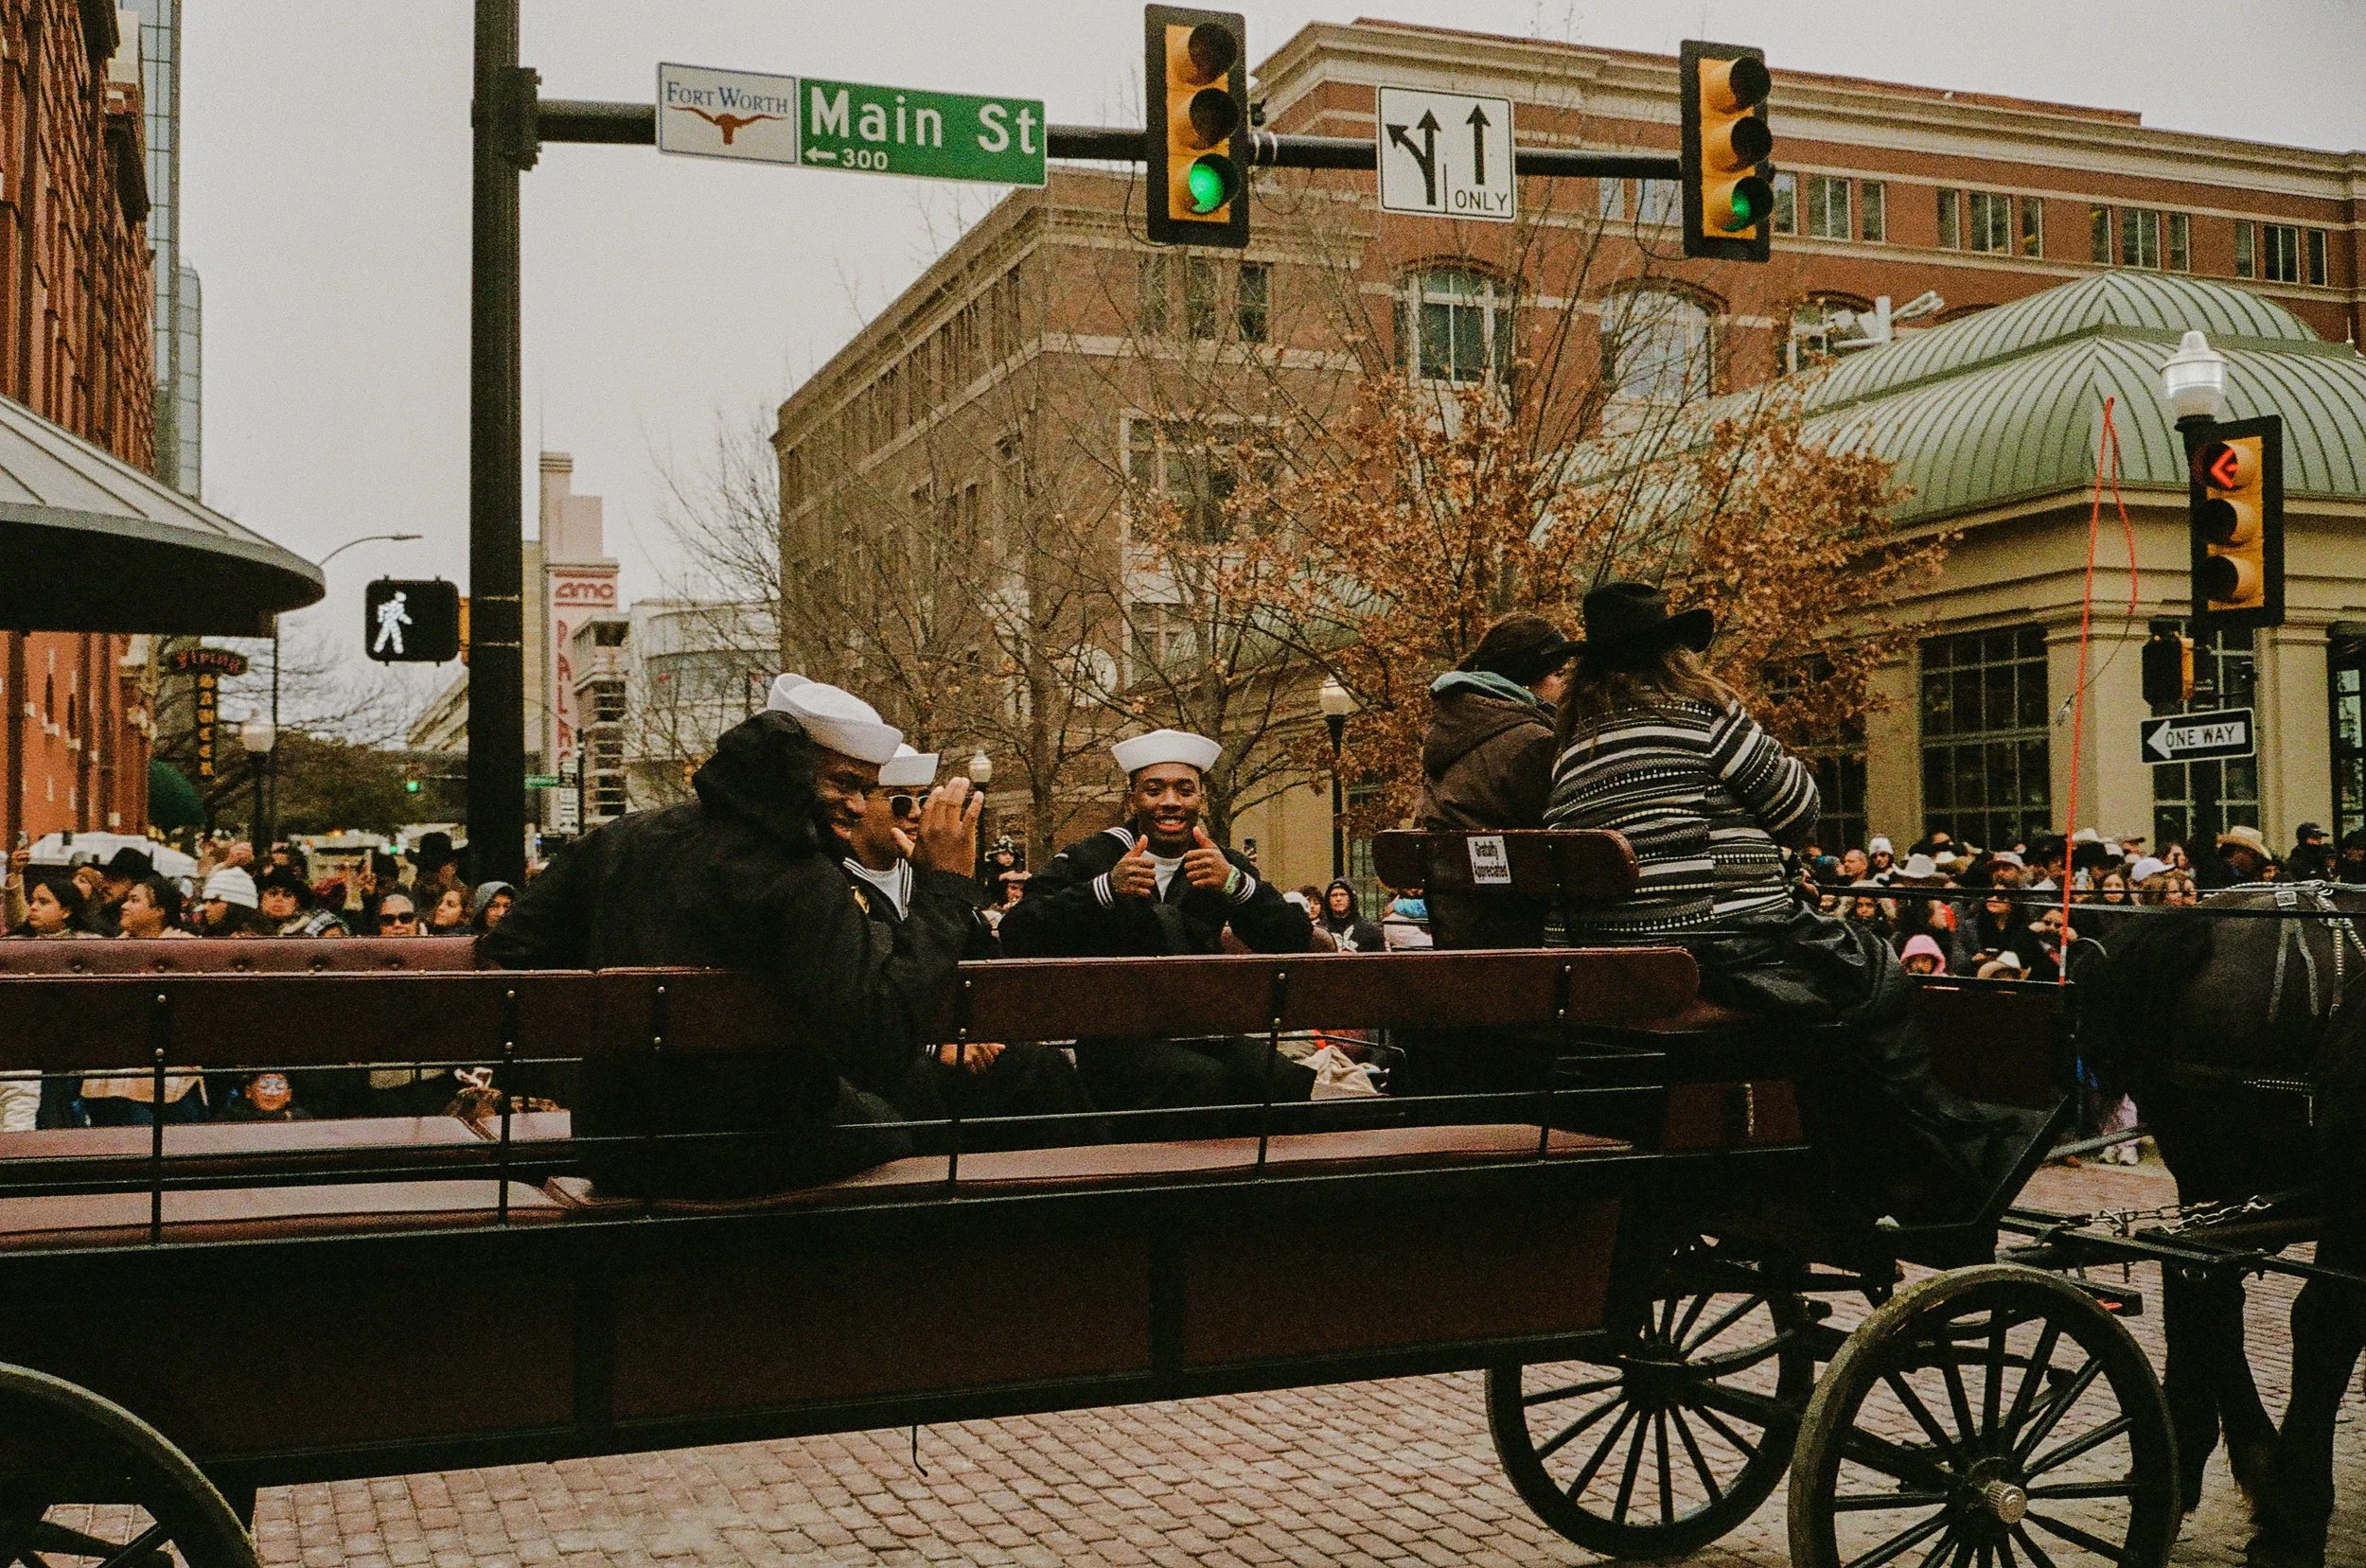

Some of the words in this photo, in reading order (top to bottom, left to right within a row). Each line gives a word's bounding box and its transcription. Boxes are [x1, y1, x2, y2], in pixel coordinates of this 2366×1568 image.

[666, 81, 715, 106] FORT
[718, 87, 787, 113] WORTH
[810, 87, 943, 148] Main
[978, 104, 1036, 154] St
[842, 148, 888, 170] 300
[1455, 189, 1508, 211] ONLY
[2165, 729, 2196, 748] ONE
[2202, 725, 2234, 744] WAY
